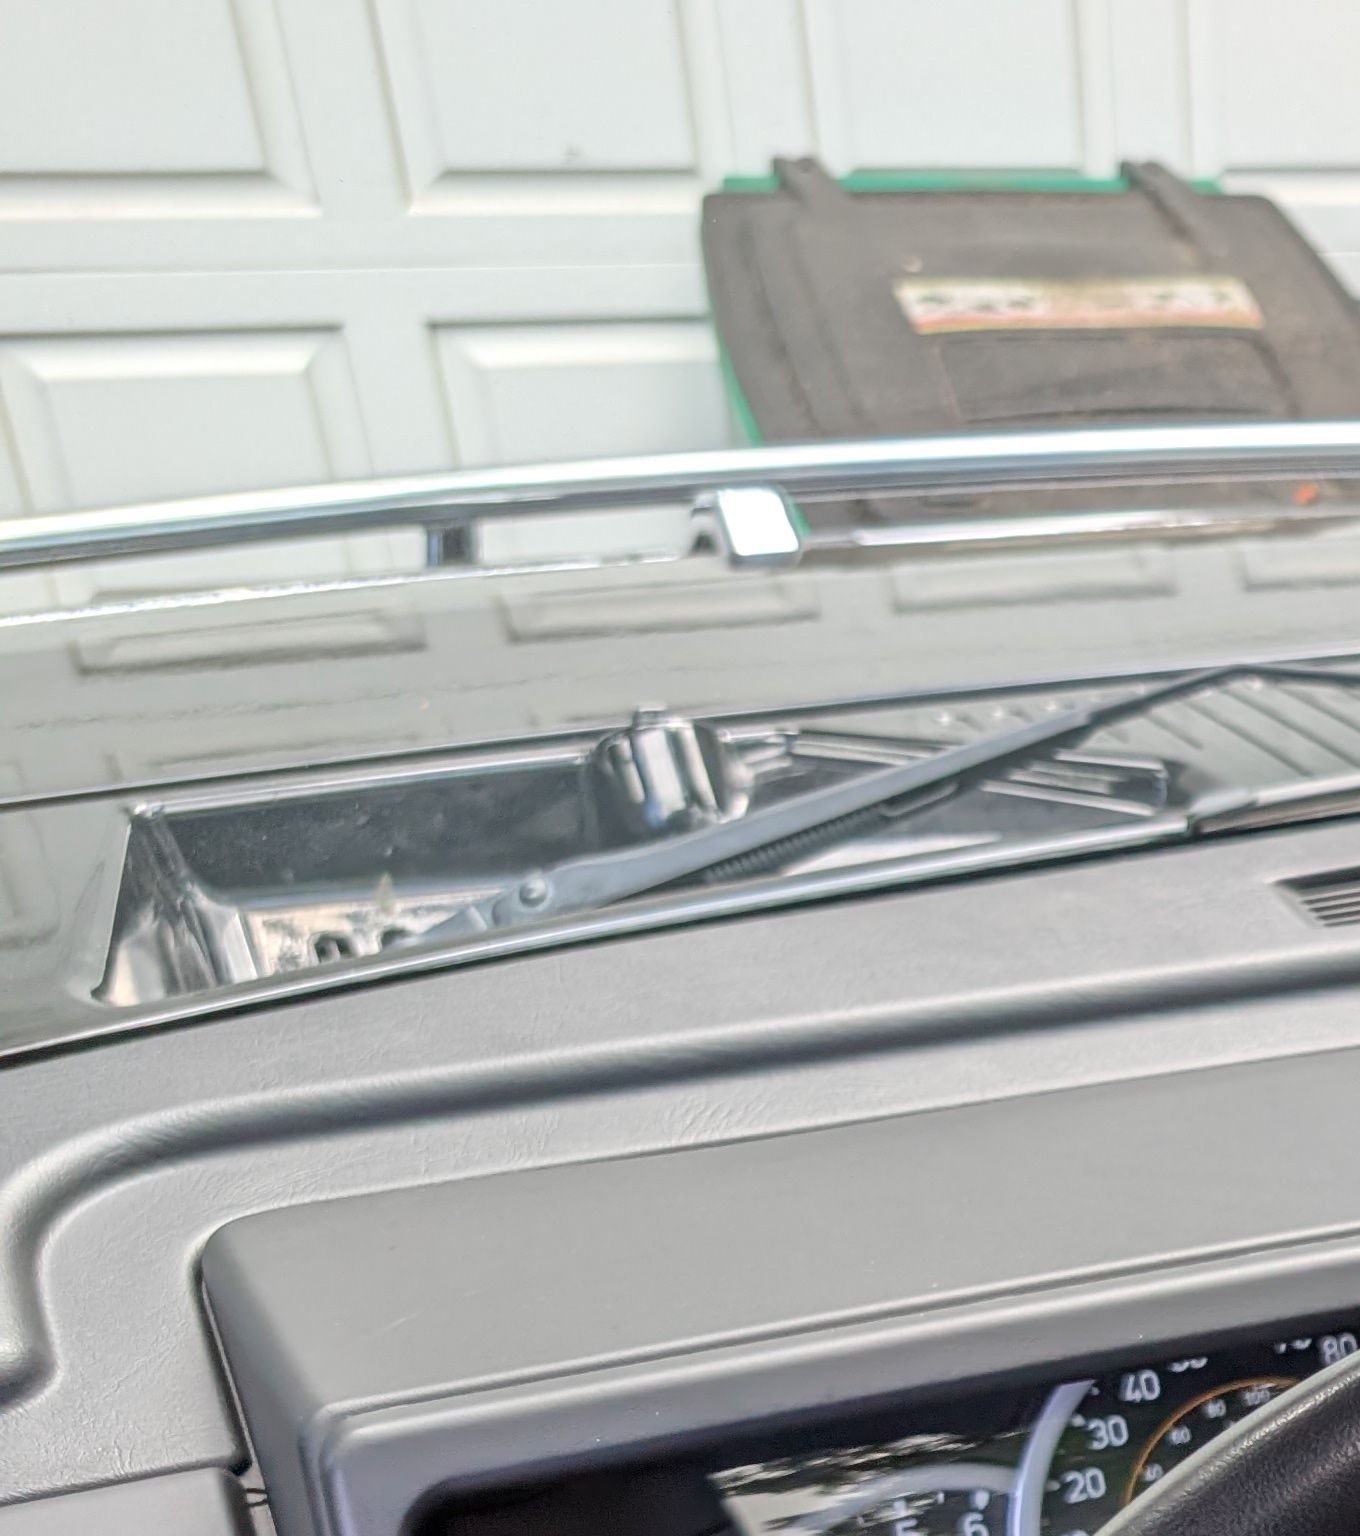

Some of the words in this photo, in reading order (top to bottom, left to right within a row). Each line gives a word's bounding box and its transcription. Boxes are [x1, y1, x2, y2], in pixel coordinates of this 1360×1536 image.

[1121, 1369, 1161, 1402] 40
[1087, 1414, 1129, 1450] 30
[1063, 1466, 1106, 1503] 20
